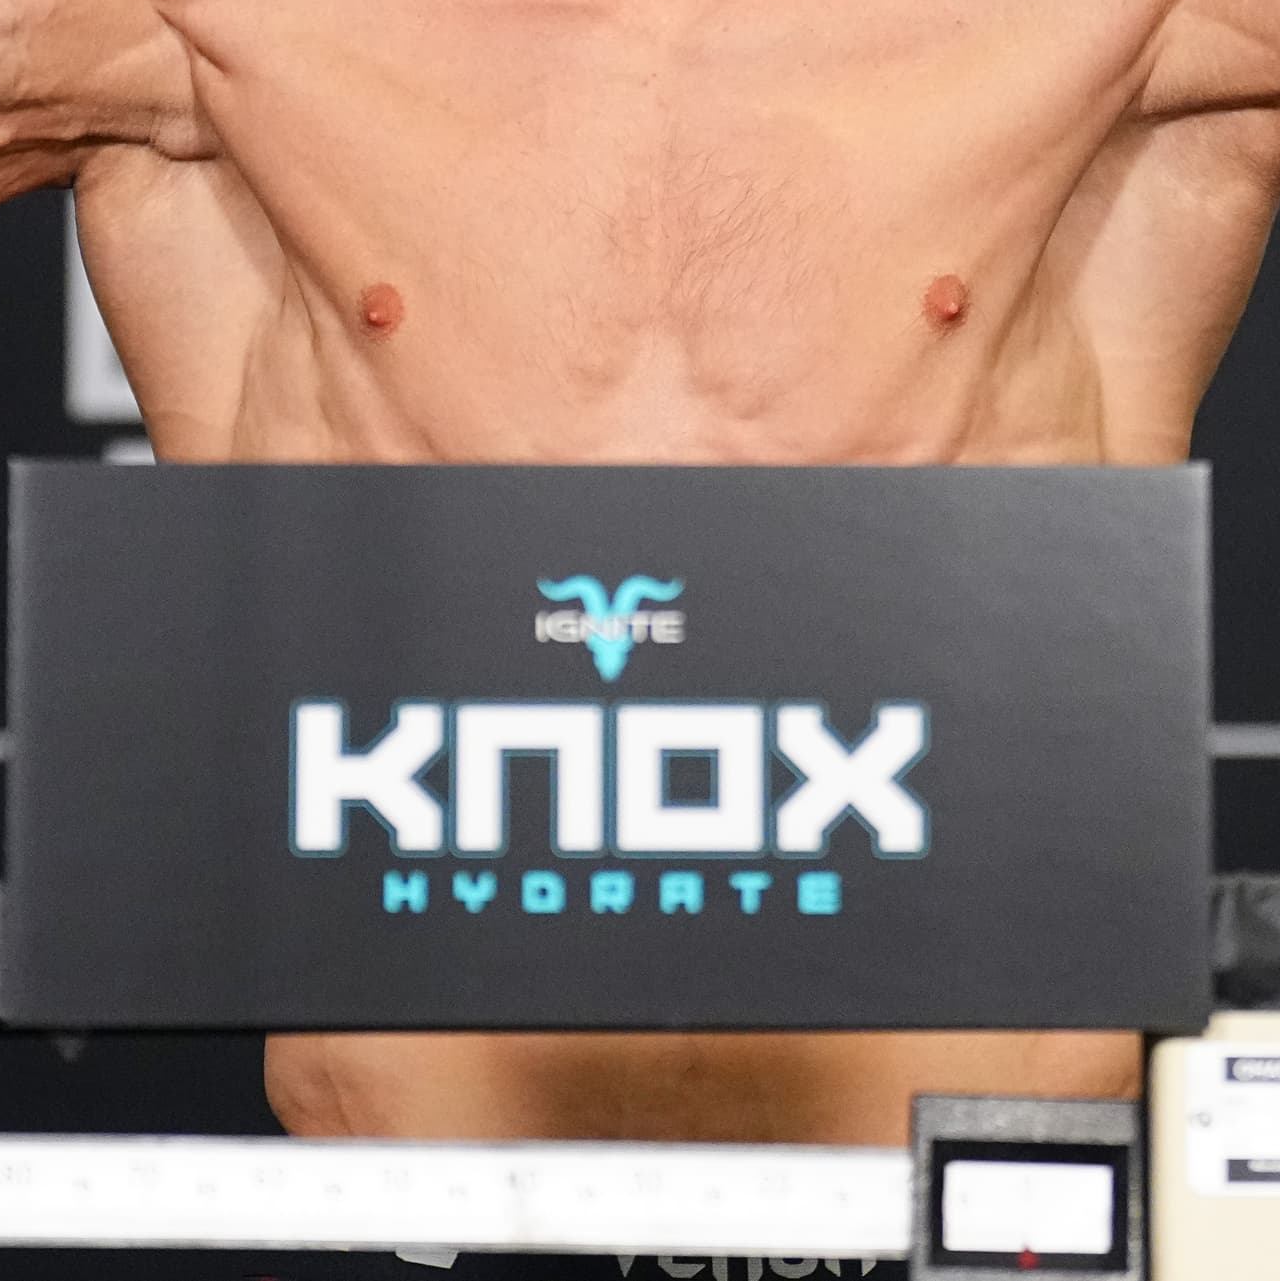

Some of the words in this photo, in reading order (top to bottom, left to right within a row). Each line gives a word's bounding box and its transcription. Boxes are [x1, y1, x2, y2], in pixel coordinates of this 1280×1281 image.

[534, 609, 687, 644] IGNITE
[293, 703, 927, 854] KNOX
[382, 871, 842, 915] HYDRATE
